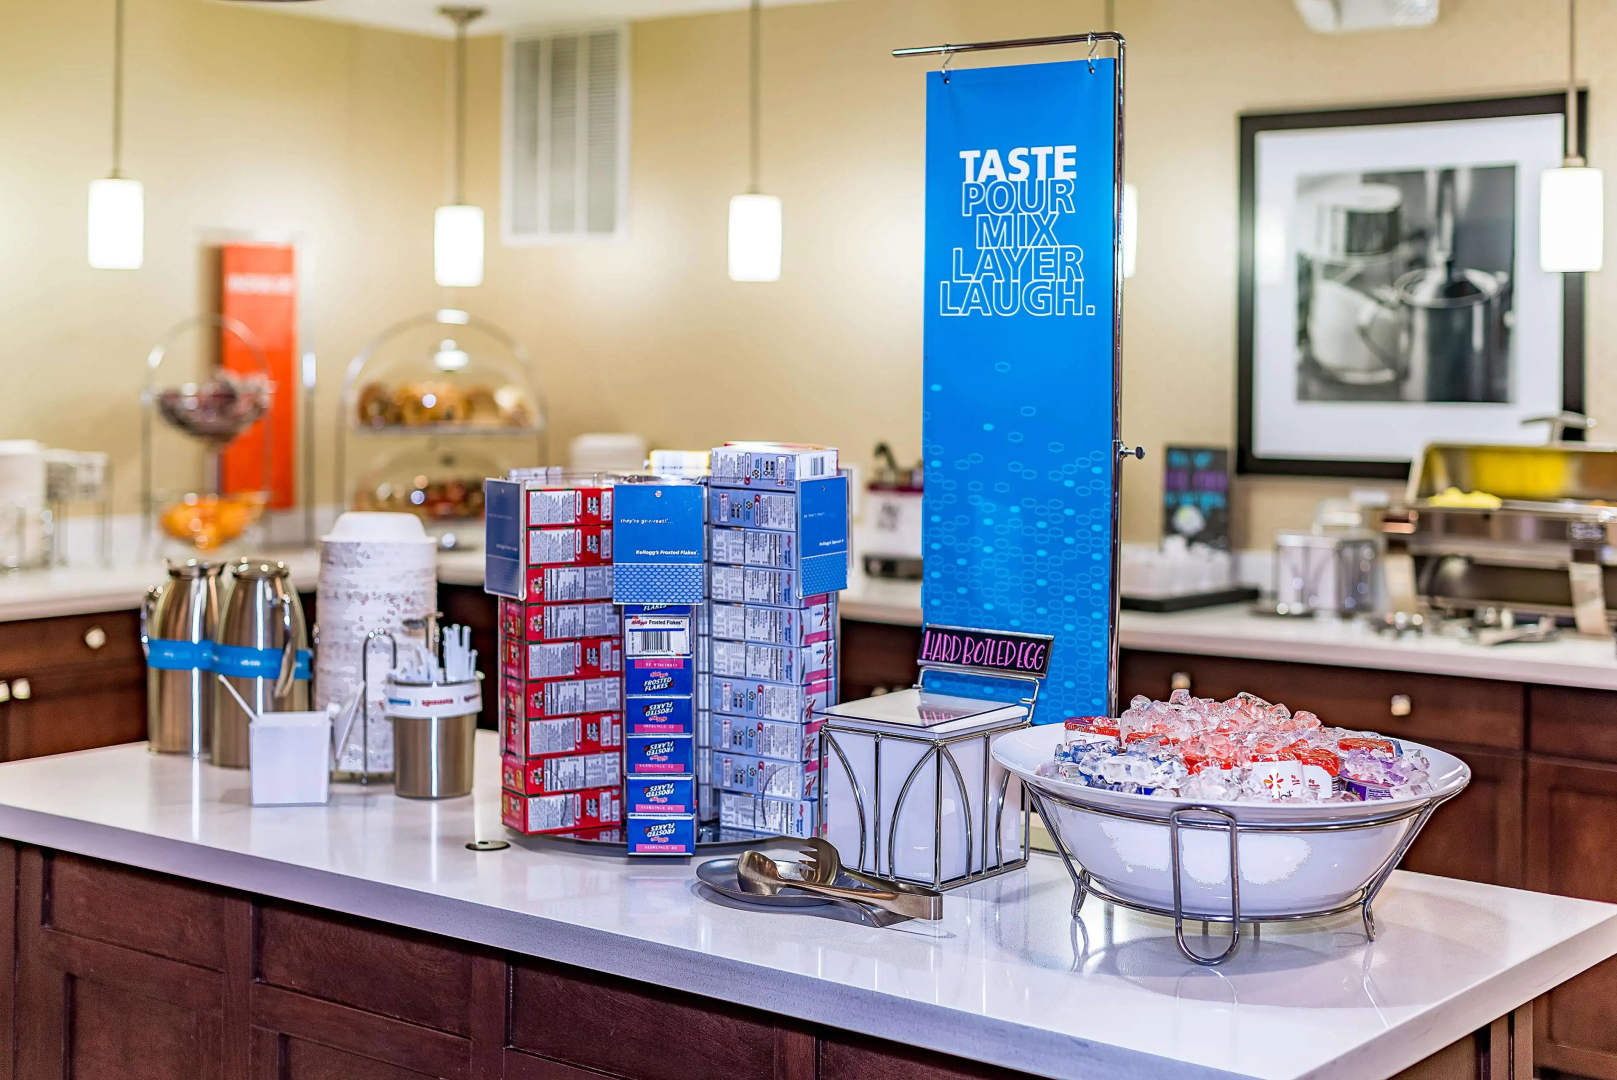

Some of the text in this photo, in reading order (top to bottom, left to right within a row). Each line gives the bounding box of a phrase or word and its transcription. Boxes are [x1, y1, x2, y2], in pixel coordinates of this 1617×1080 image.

[959, 145, 1077, 182] TASTE
[962, 178, 1075, 217] POUR
[976, 212, 1060, 249] MIX
[953, 245, 1084, 283] LAYER
[940, 280, 1095, 316] LAUGH.
[922, 631, 1045, 670] HARD BOILED EGG
[644, 677, 672, 686] FROSTED
[645, 683, 668, 692] FLAKES
[649, 701, 673, 710] FLAKES
[645, 707, 673, 716] FROSTED
[650, 741, 674, 750] FLAKES
[646, 746, 674, 756] FROSTED
[650, 782, 674, 791] FLAKES
[646, 788, 674, 797] FROSTED
[651, 822, 675, 831] FLAKES
[647, 828, 675, 837] FROSTED
